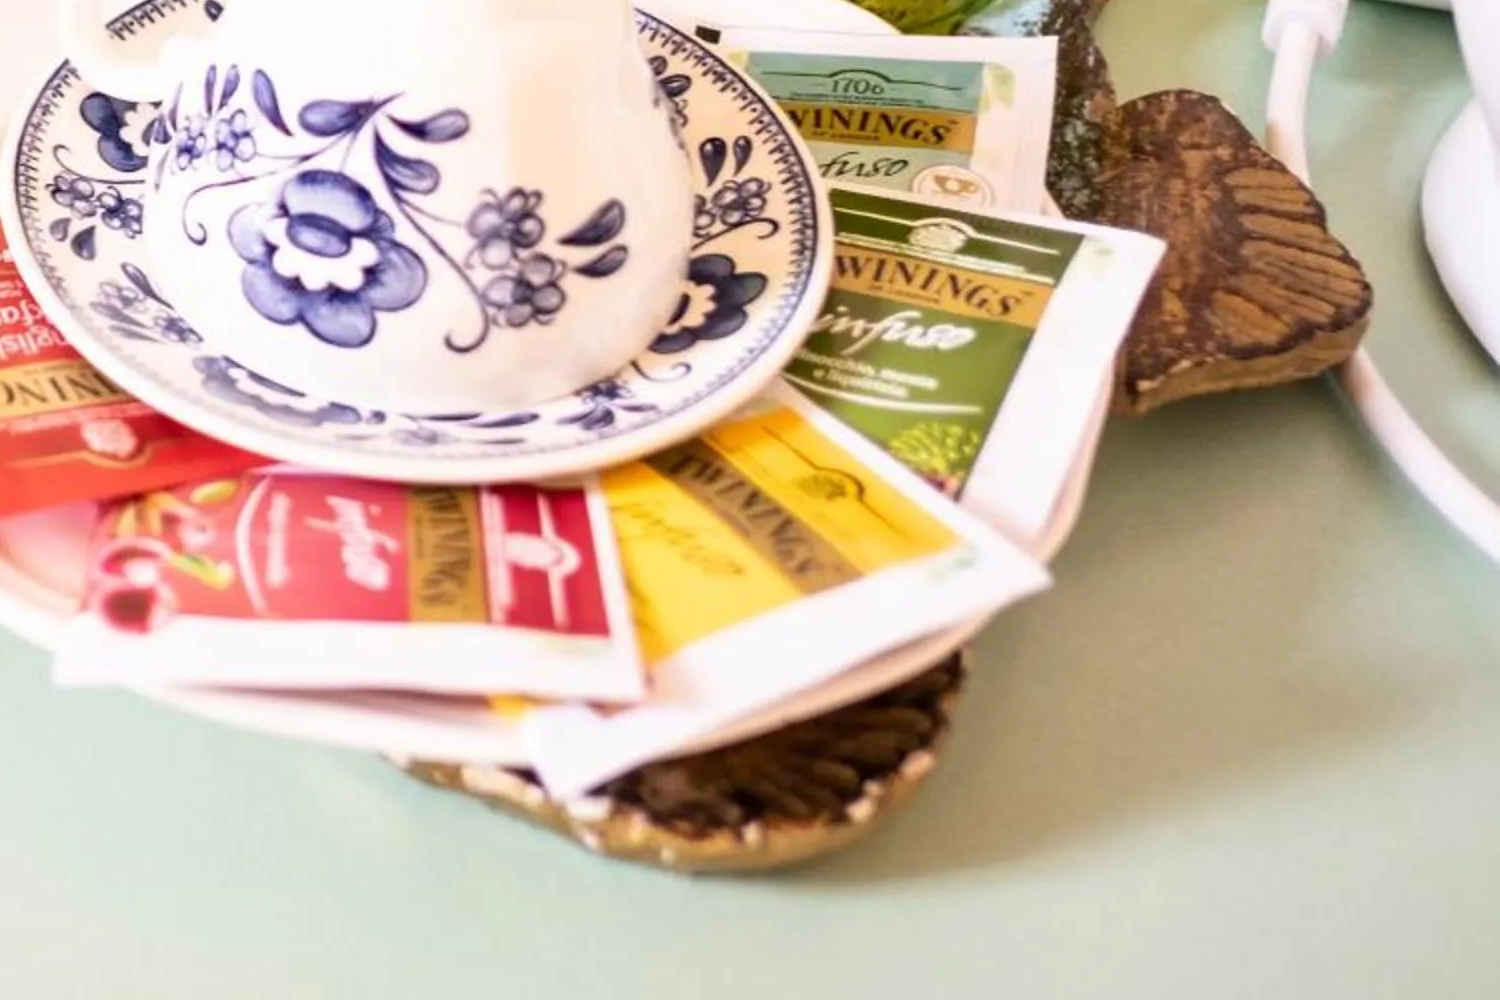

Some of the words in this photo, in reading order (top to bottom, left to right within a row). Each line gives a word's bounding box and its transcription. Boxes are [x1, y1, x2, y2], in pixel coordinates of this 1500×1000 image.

[831, 77, 885, 96] 1706
[818, 151, 909, 178] fuso
[835, 254, 1023, 317] WININGS
[809, 304, 977, 355] infuso
